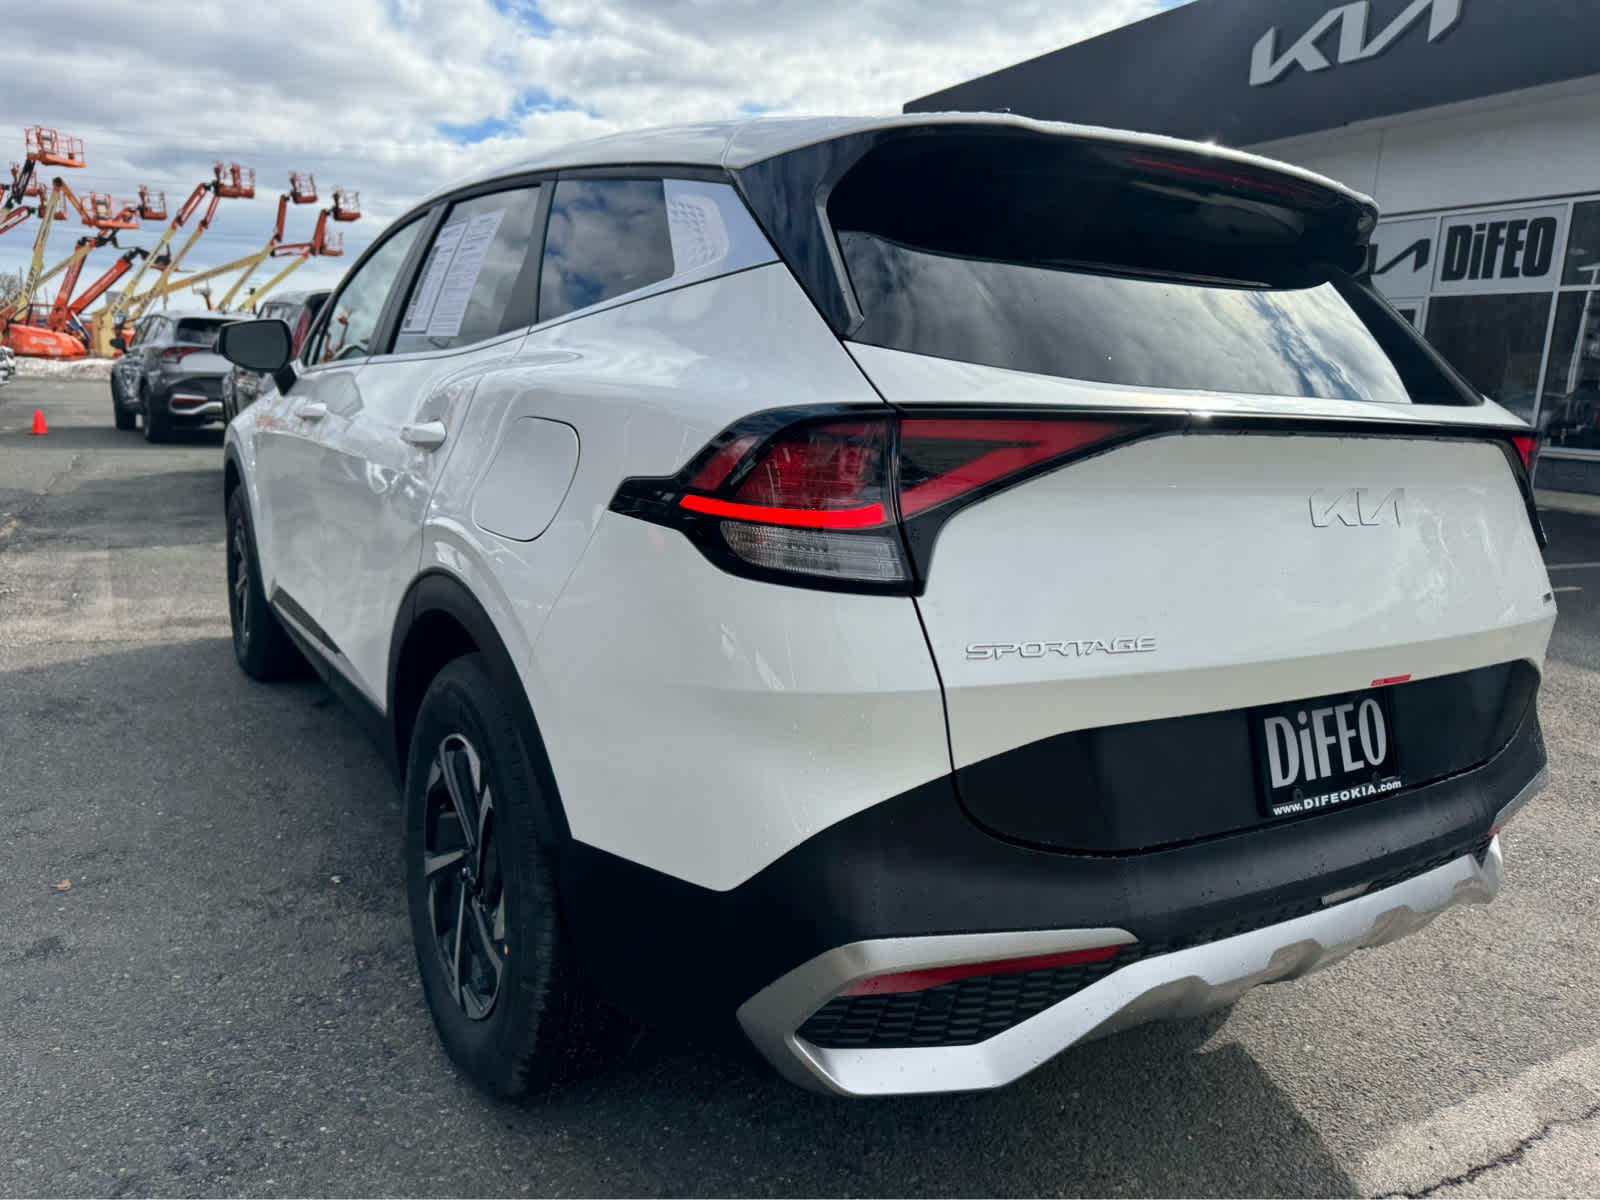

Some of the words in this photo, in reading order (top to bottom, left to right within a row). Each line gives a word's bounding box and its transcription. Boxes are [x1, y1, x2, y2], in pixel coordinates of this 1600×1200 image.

[1250, 0, 1461, 85] KIA
[1440, 216, 1557, 282] DiFEO
[1308, 488, 1405, 528] KIA
[966, 635, 1156, 660] SPORTAGE
[1264, 698, 1387, 788] DiFEO
[1273, 780, 1402, 816] www.DIFEOKIA.com
